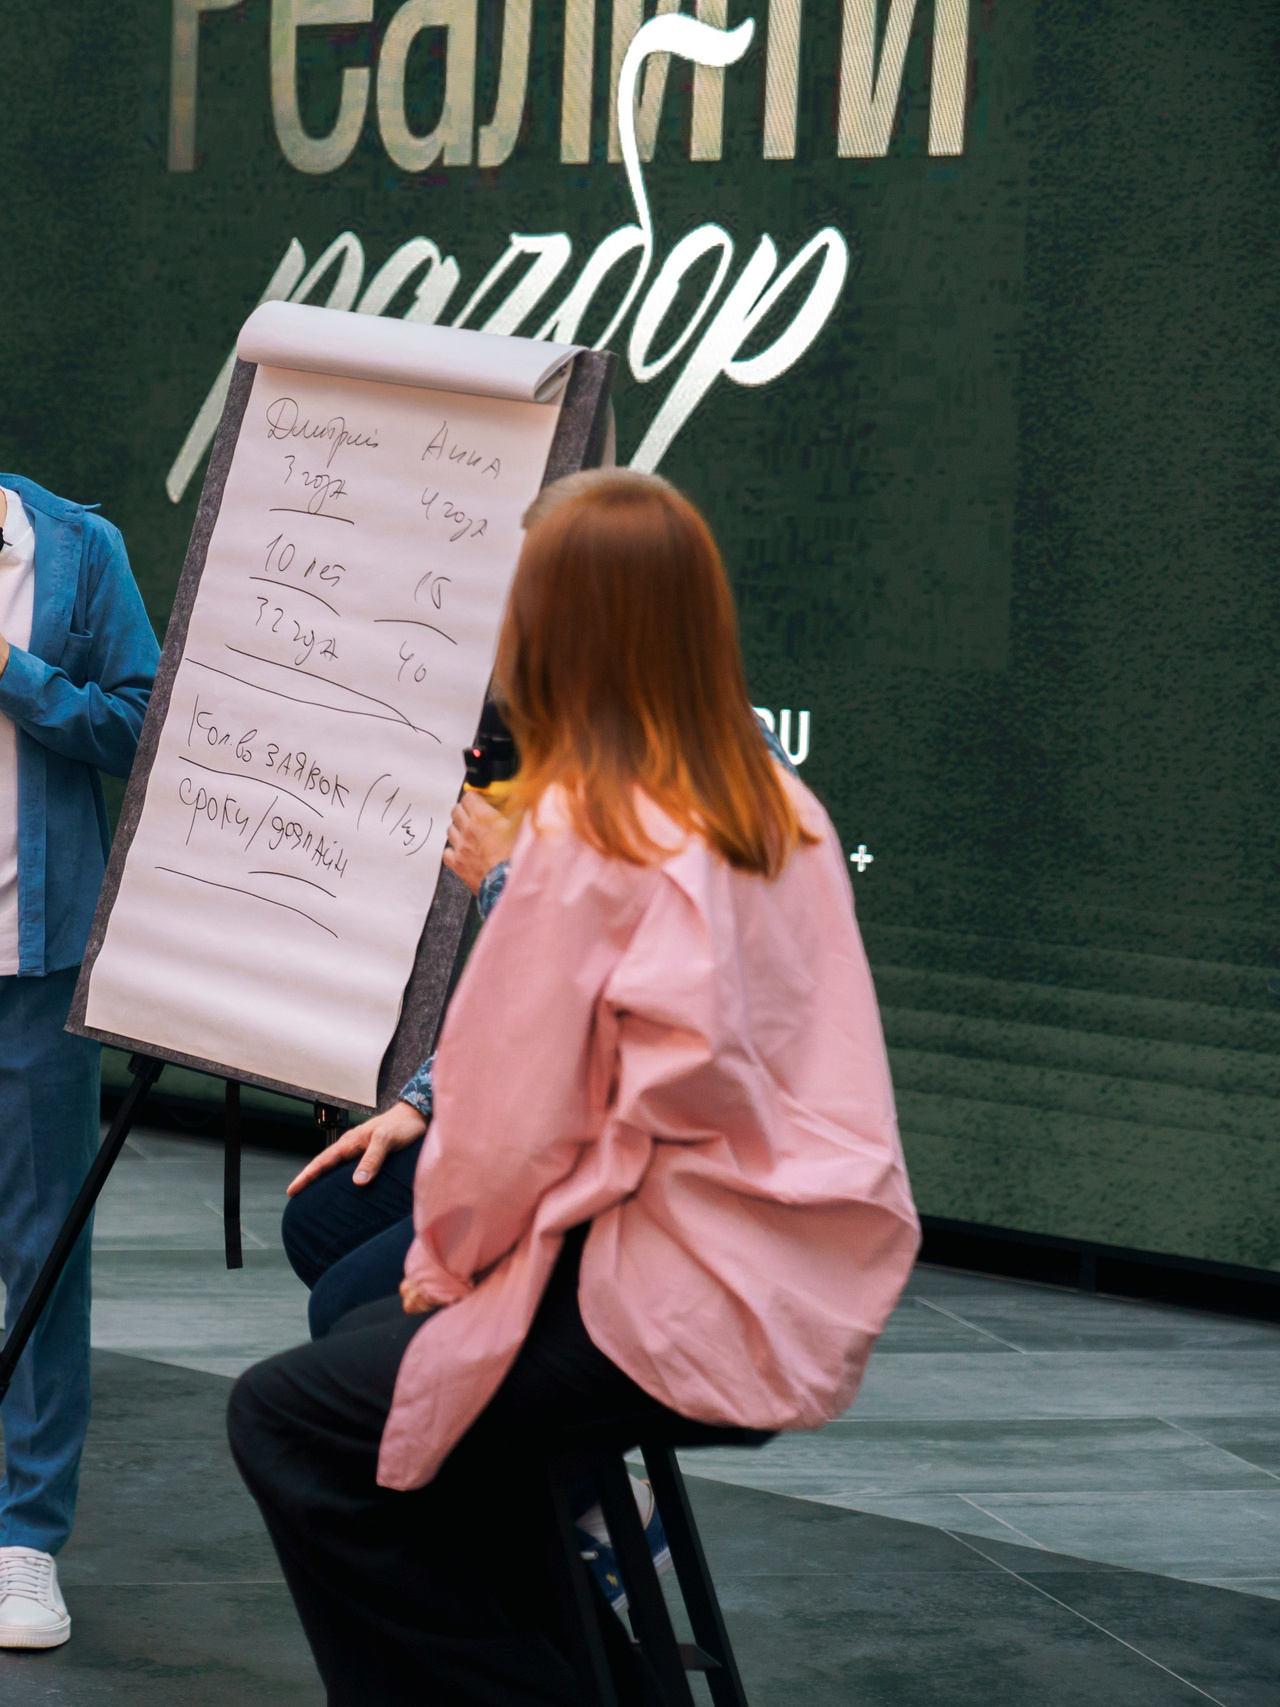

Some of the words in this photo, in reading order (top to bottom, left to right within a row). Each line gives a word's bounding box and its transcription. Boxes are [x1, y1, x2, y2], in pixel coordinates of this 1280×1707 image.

[284, 455, 296, 484] 3
[420, 488, 439, 520] 4
[264, 533, 296, 572] 10
[397, 640, 427, 682] 40
